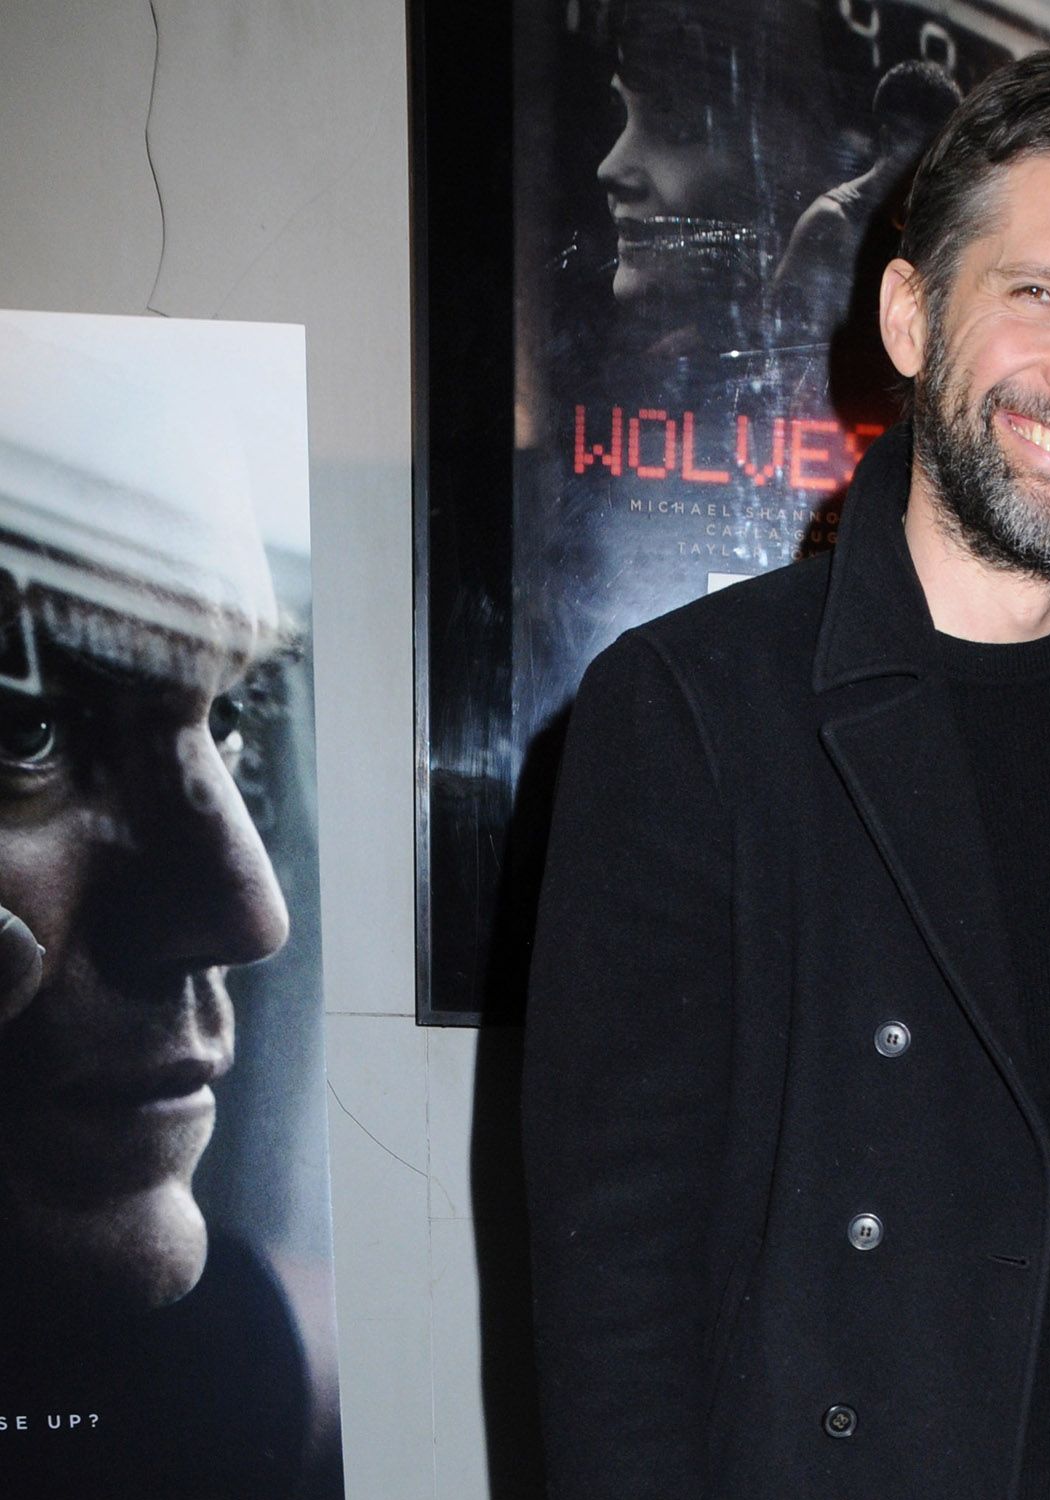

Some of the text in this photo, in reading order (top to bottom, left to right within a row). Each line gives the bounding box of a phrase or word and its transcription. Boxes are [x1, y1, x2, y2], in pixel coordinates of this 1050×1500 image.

[630, 499, 730, 517] MICHAEL
[706, 523, 779, 541] CALA
[678, 541, 762, 559] TAYLR
[0, 1413, 99, 1430] SE UP?
